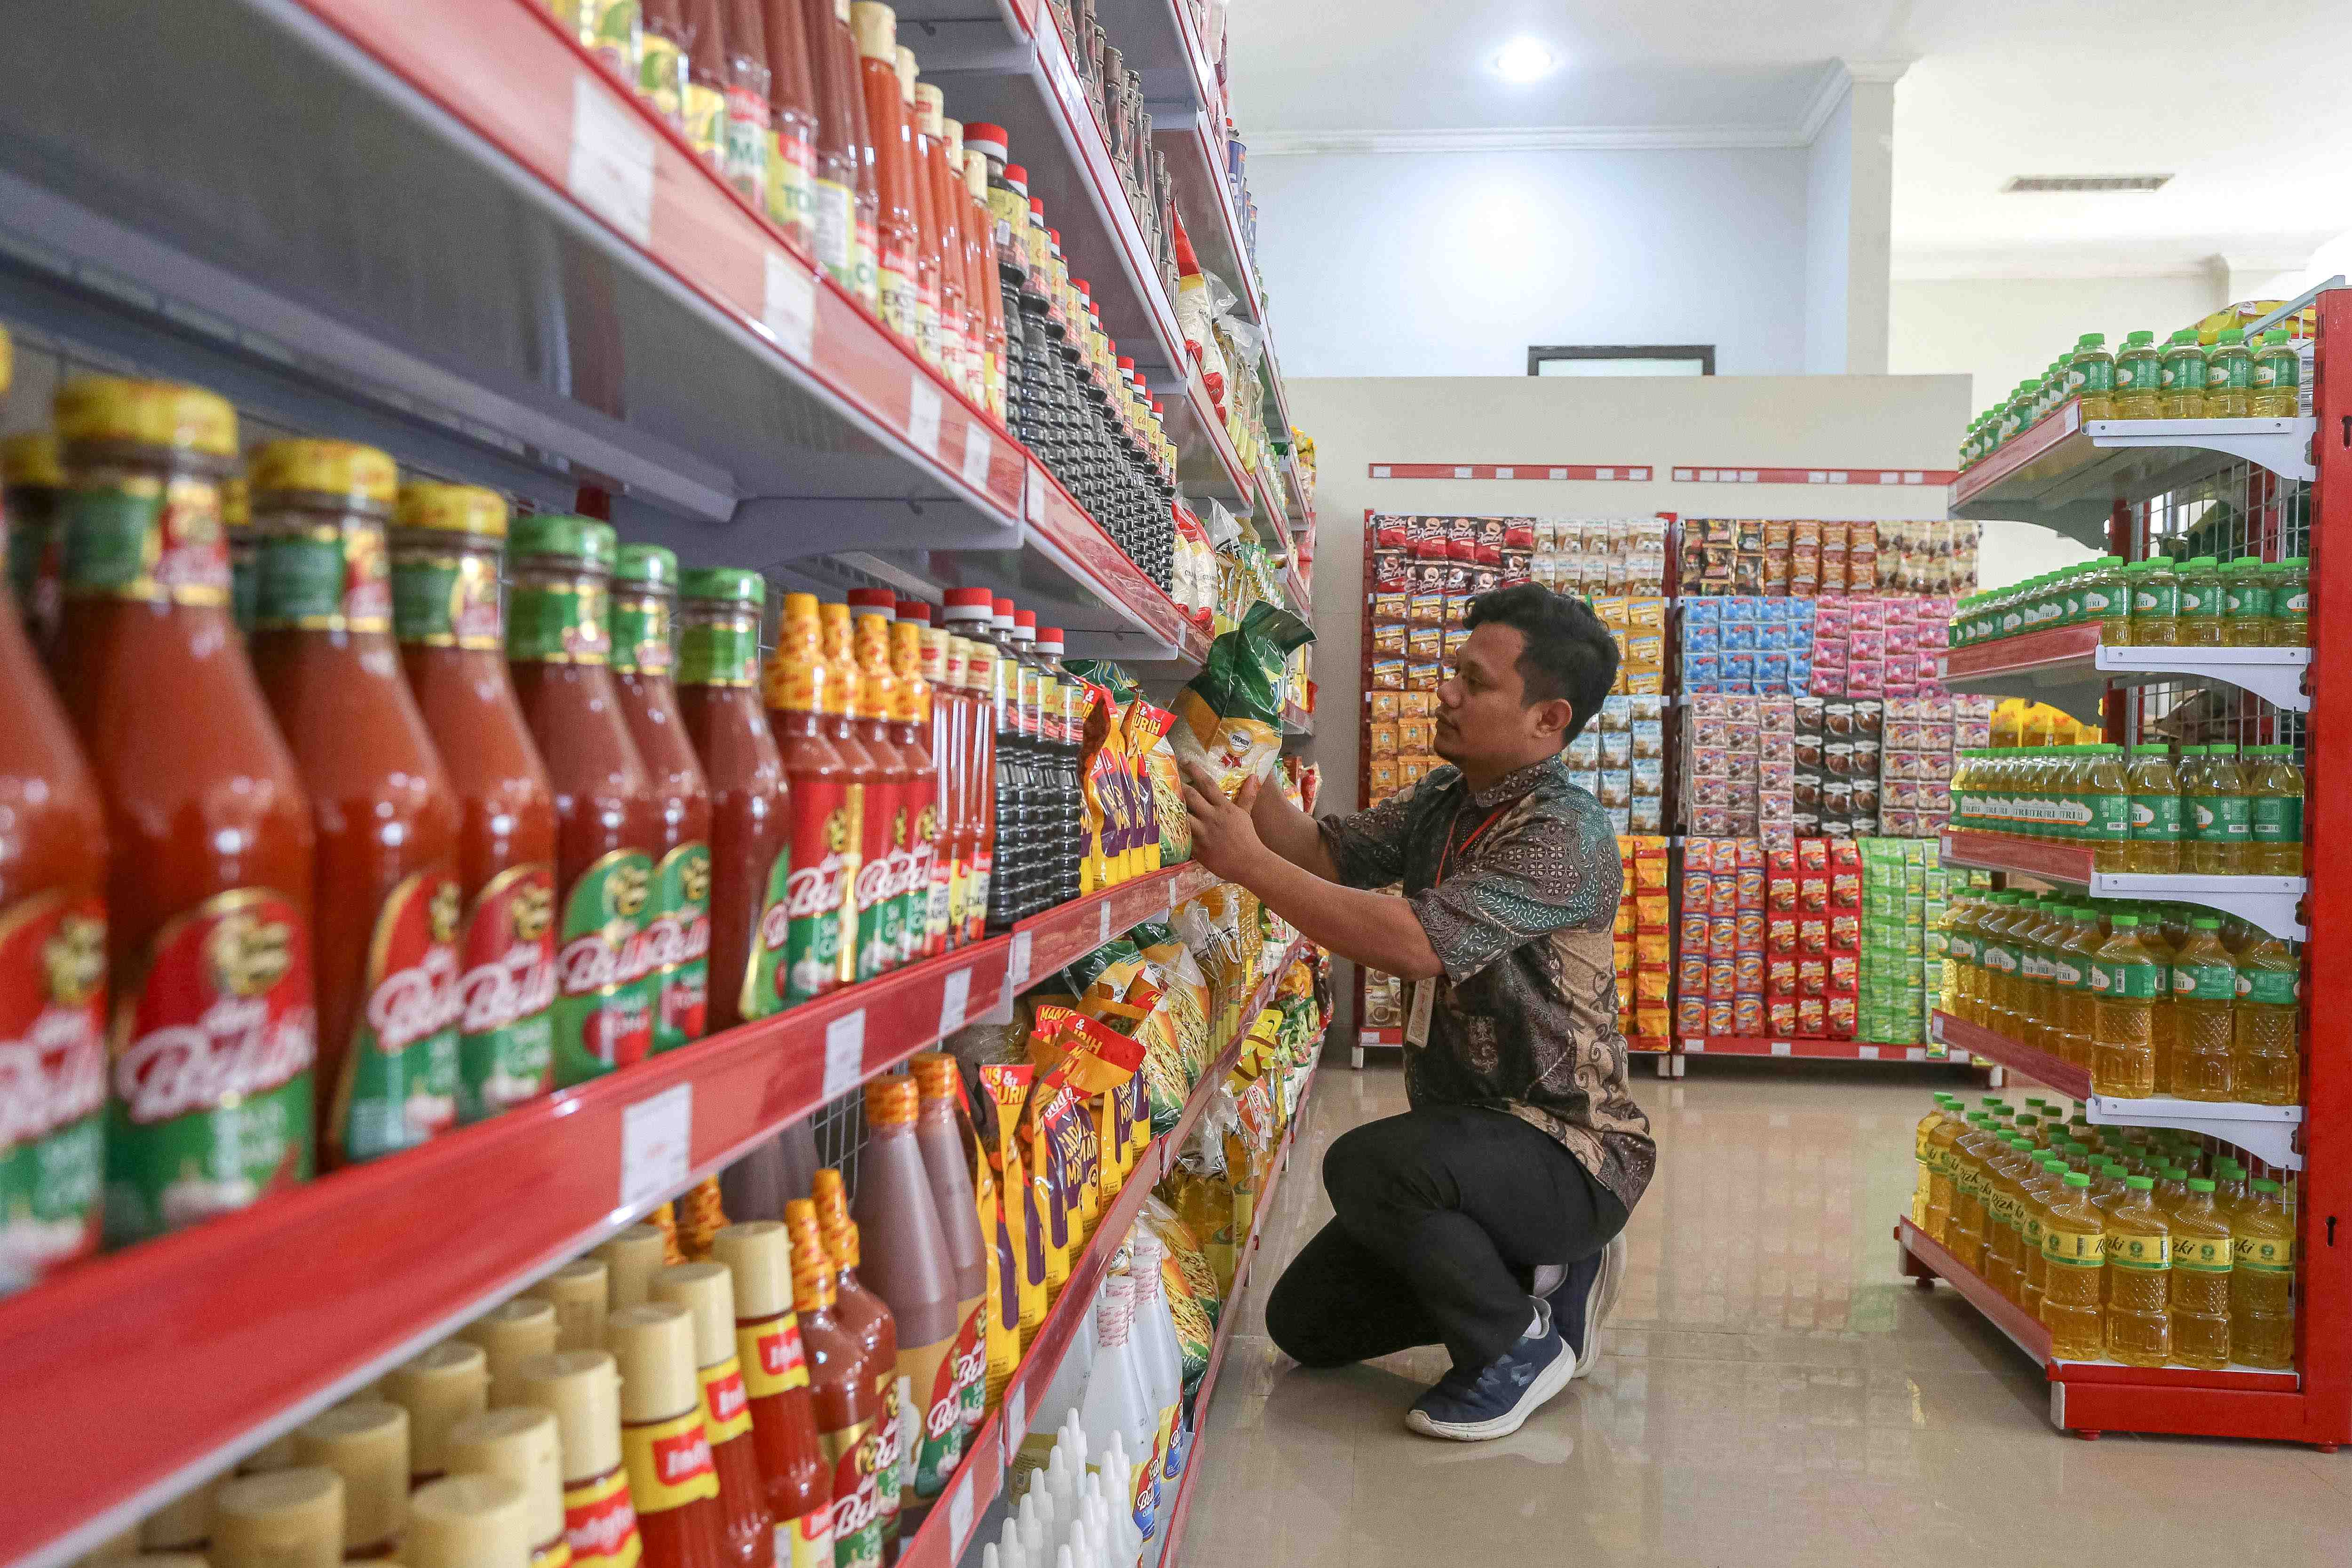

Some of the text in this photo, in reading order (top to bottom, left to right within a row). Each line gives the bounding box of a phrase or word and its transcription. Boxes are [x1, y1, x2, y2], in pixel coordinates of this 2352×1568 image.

[1040, 1006, 1077, 1021] MANI
[2107, 1235, 2125, 1252] zki
[2173, 1238, 2193, 1254] zki
[2234, 1239, 2253, 1255] zki
